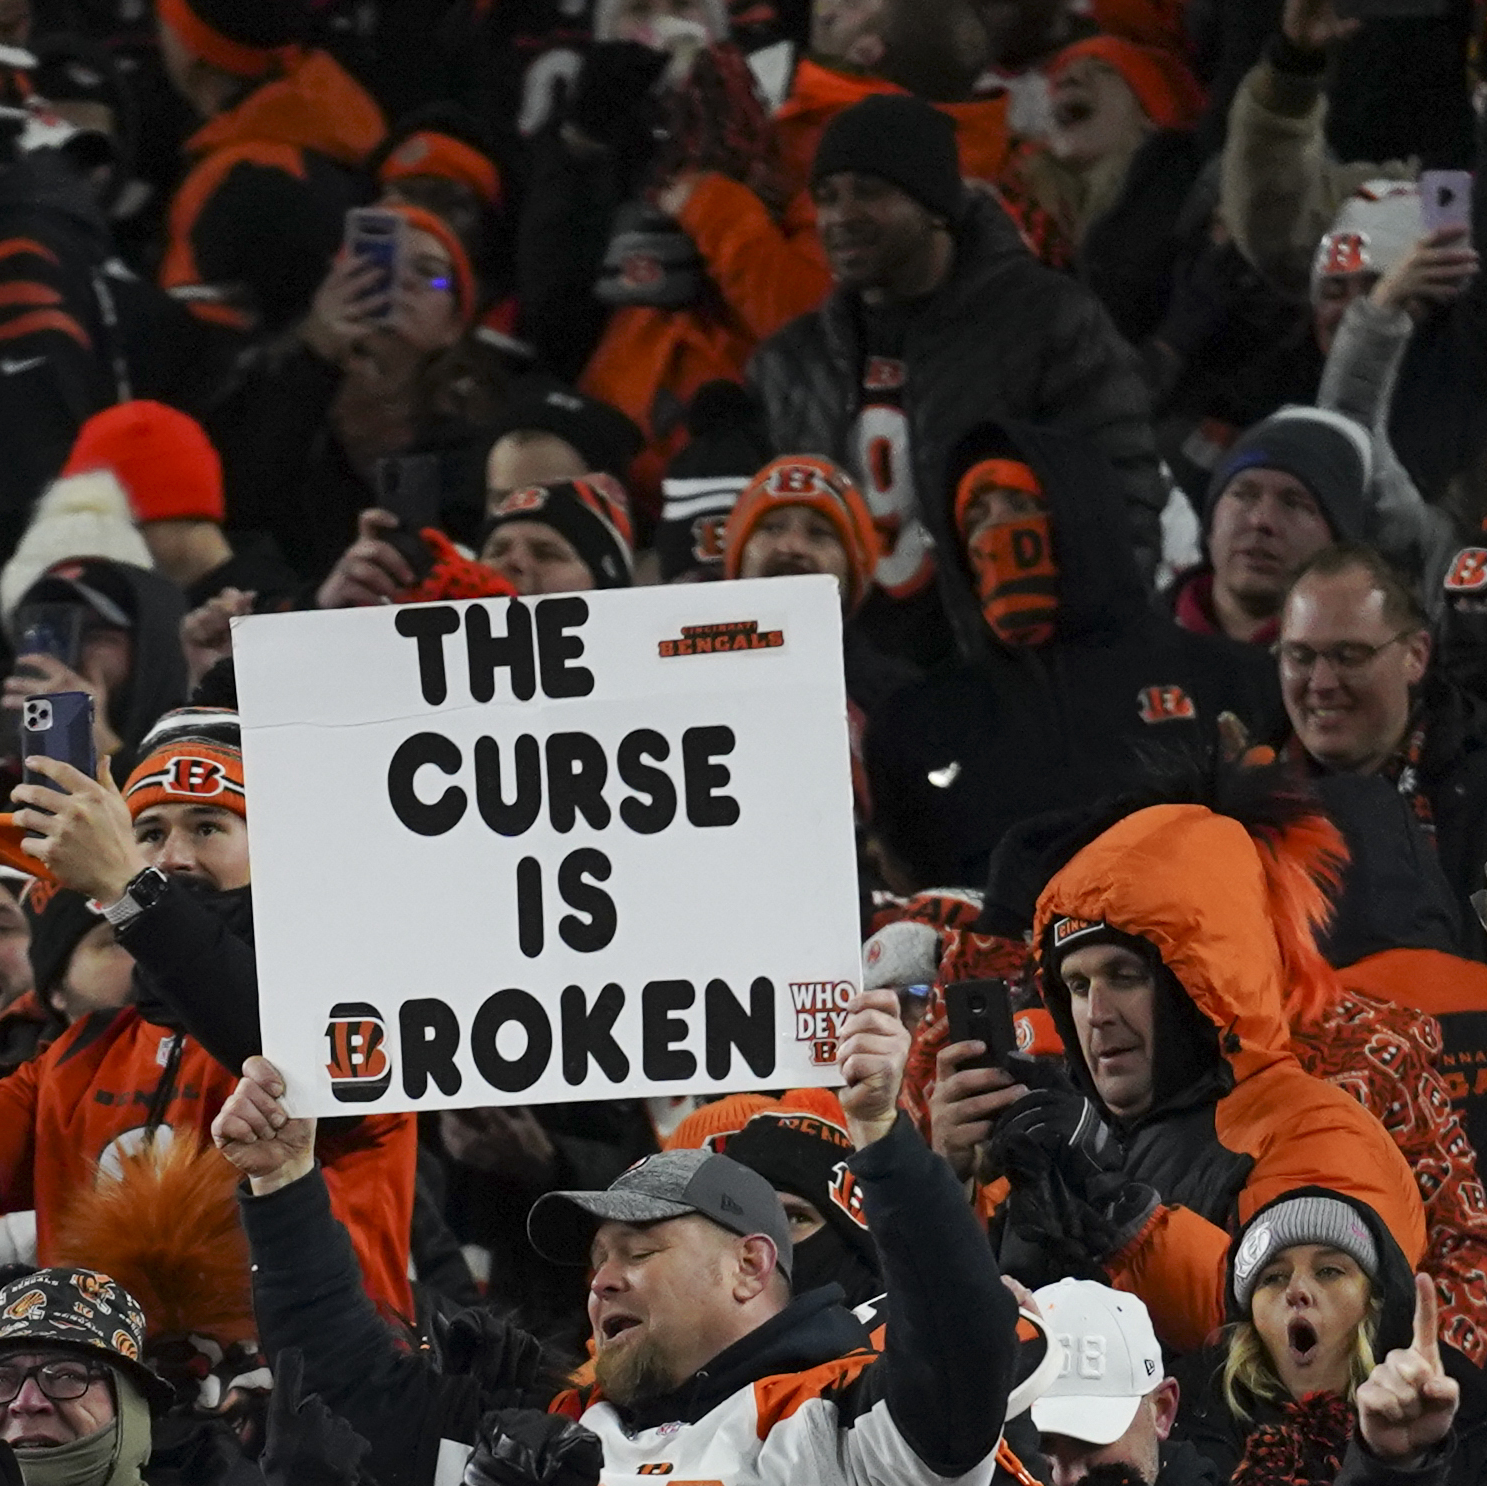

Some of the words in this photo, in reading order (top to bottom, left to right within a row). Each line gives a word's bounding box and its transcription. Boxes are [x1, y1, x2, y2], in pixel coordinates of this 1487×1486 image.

[395, 597, 595, 706] THE
[658, 630, 784, 657] BENGALS
[388, 726, 741, 837] CURSE
[516, 848, 618, 959] IS
[324, 976, 776, 1103] BROKEN
[789, 982, 856, 1012] WHO
[795, 1012, 845, 1041] DEY
